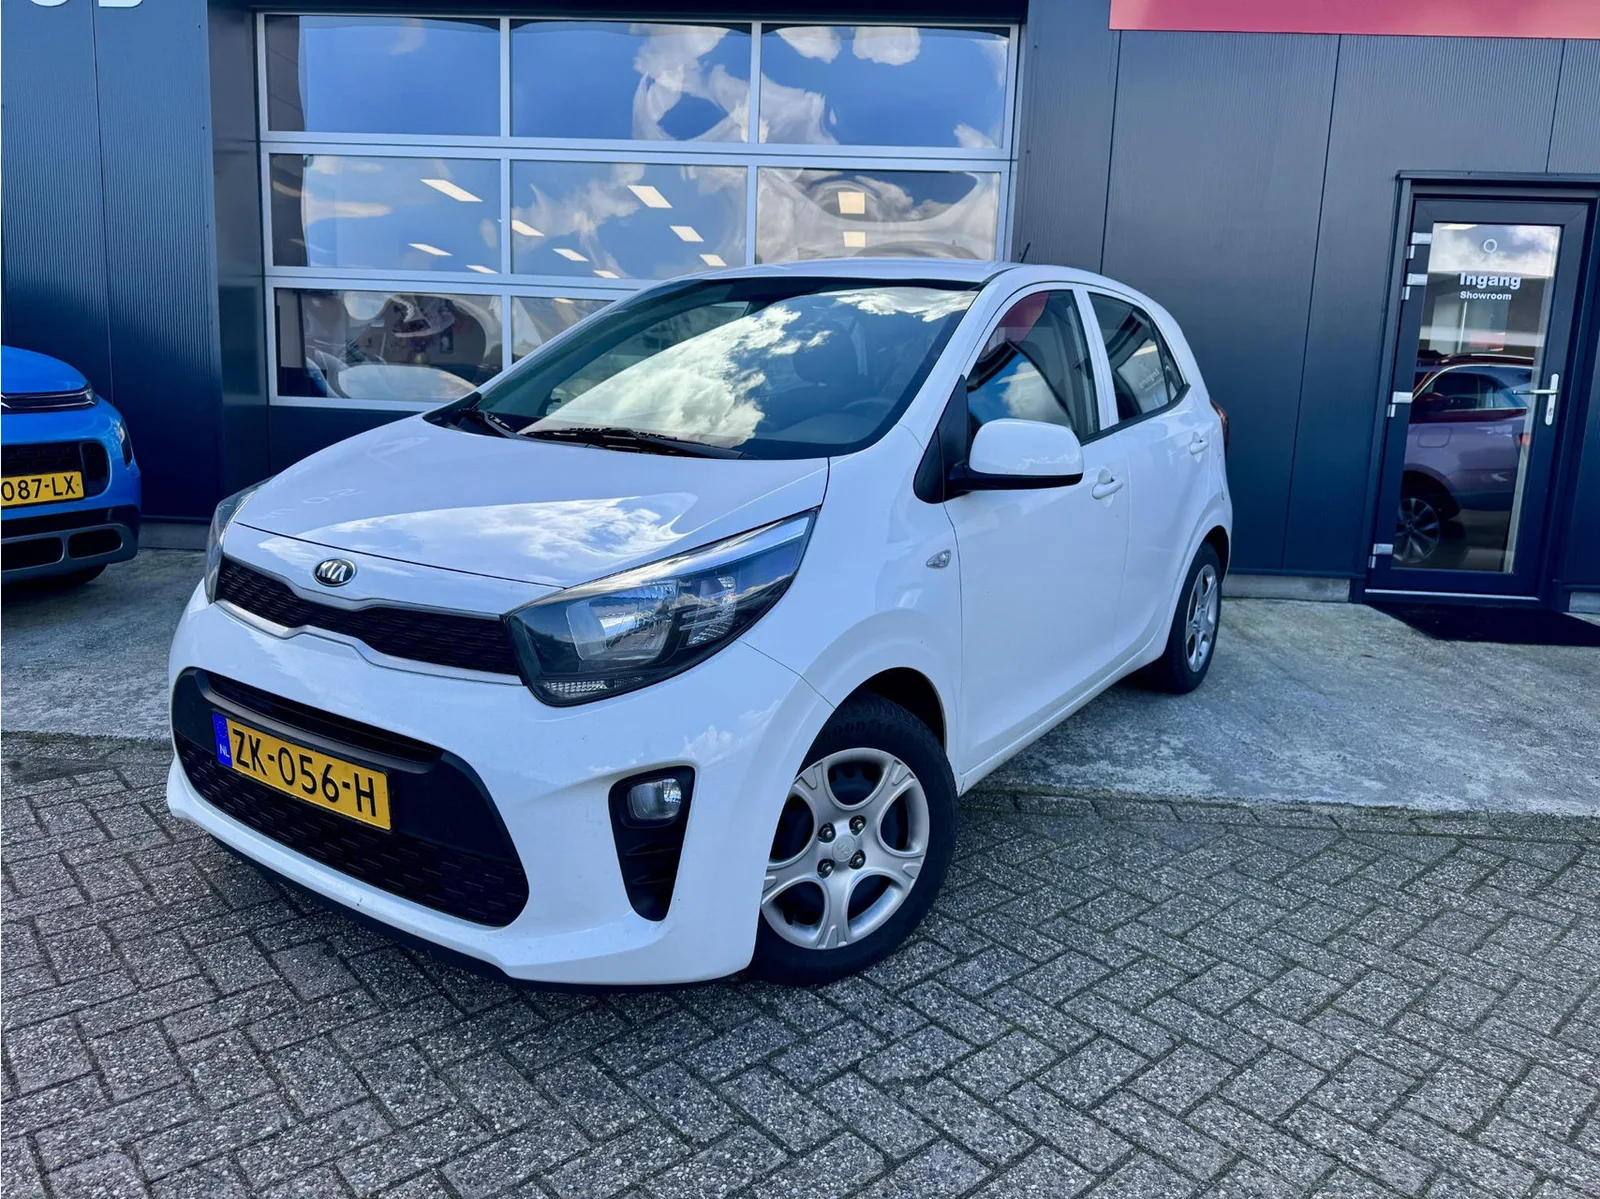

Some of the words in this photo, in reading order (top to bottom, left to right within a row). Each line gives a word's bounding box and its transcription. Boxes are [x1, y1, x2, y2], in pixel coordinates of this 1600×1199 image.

[1459, 272, 1521, 289] Ingang
[1460, 291, 1512, 300] Showroom
[1, 475, 76, 501] 087-LX
[316, 561, 348, 582] KIA
[219, 744, 231, 758] NL
[232, 728, 377, 817] ZK-056-H
